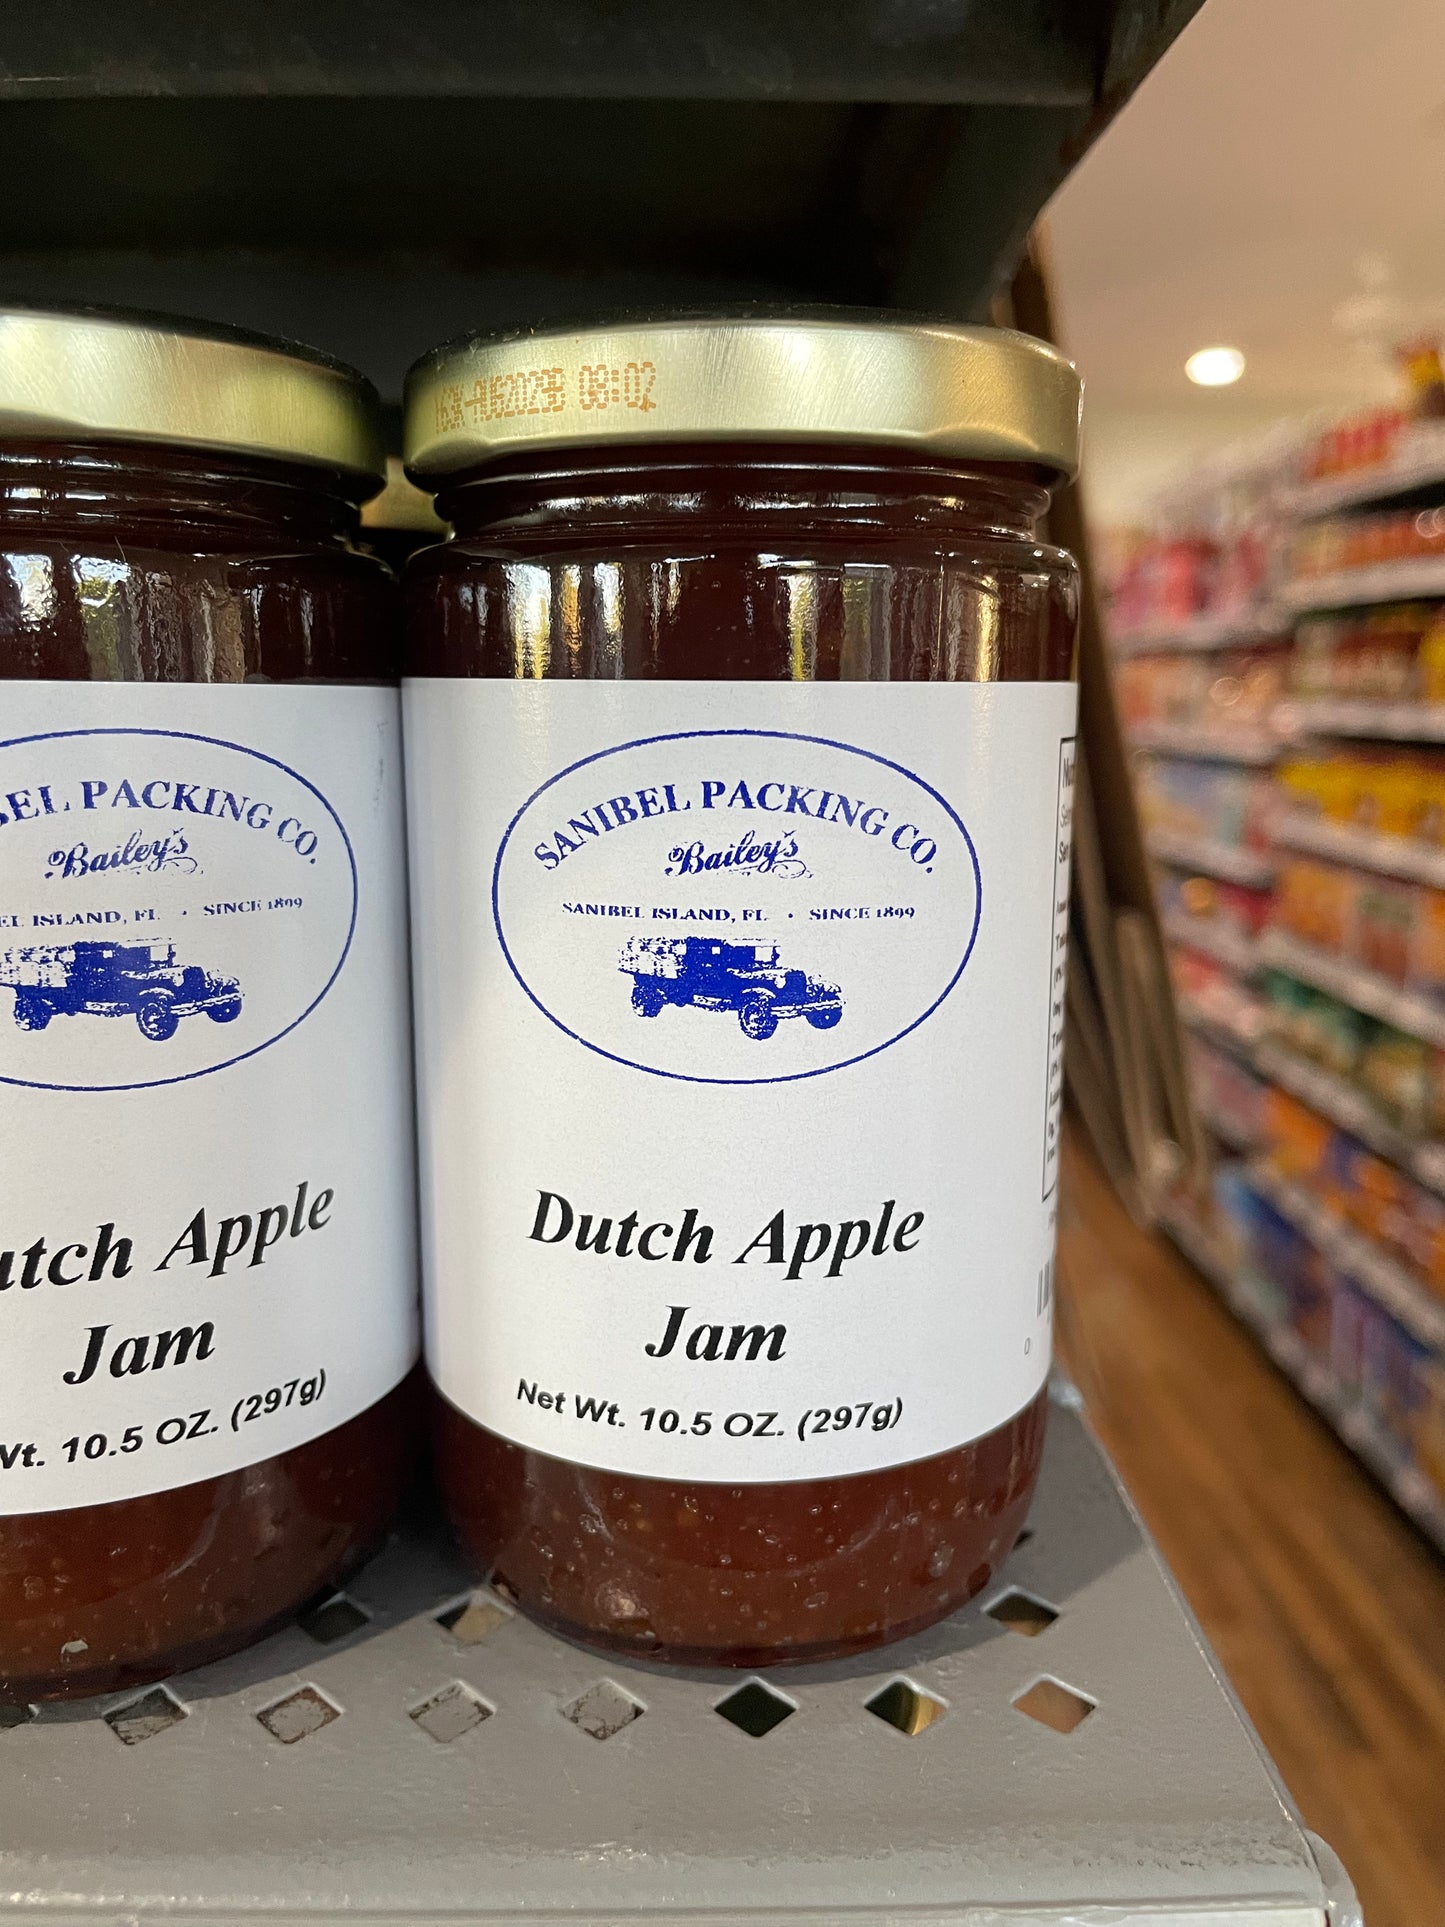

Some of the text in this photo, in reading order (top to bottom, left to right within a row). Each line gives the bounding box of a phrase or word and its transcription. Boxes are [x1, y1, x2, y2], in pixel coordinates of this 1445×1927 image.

[578, 361, 657, 412] 08:02
[44, 828, 204, 879] Bailey's
[80, 779, 273, 830] PACKING
[277, 817, 320, 865] CO.
[533, 780, 938, 874] SANIBEL PACKING CO.
[664, 830, 814, 879] Bailey's
[33, 911, 128, 926] ISLAND,
[203, 899, 262, 917] SINCE
[562, 902, 646, 919] SANIBEL
[651, 907, 736, 924] ISLAND,
[808, 906, 870, 920] SINCE
[153, 1180, 335, 1279] Apple
[525, 1189, 925, 1281] Dutch Apple
[62, 1320, 216, 1385] Jam
[644, 1304, 788, 1362] Jam
[62, 1426, 144, 1464] 10.5
[156, 1409, 219, 1445] OZ.
[230, 1367, 327, 1433] (297g)
[516, 1378, 903, 1442] Net Wt. 10.5 OZ. (297g)
